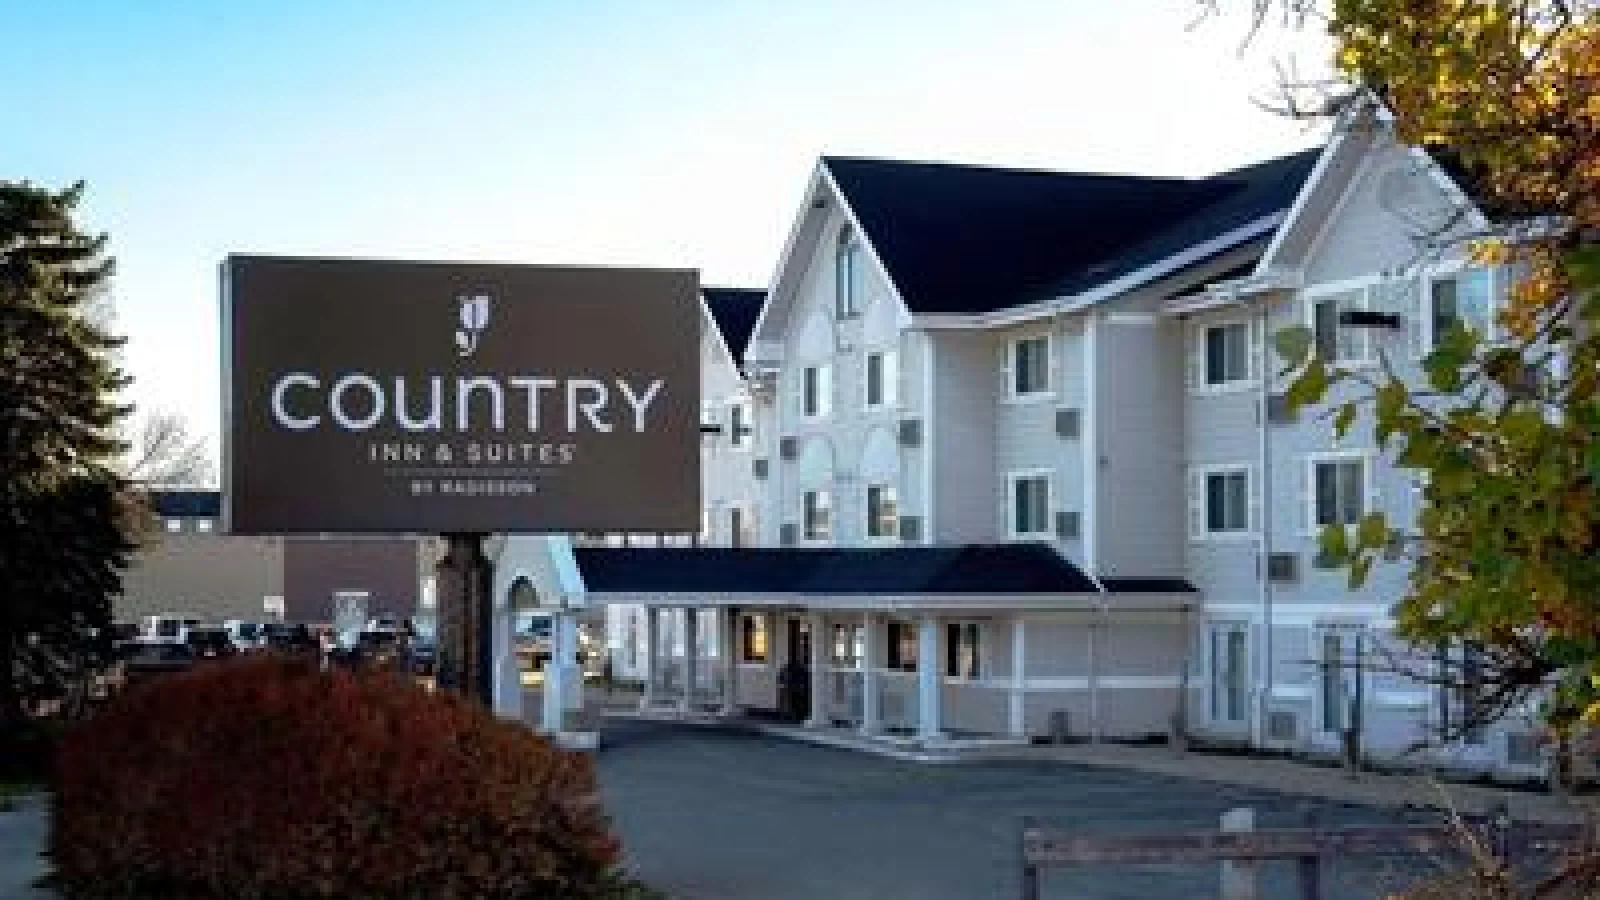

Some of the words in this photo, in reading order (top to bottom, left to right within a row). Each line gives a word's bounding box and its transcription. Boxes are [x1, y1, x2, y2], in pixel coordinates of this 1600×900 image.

[369, 443, 422, 463] INN
[434, 443, 453, 464] &
[467, 443, 576, 465] SUITES
